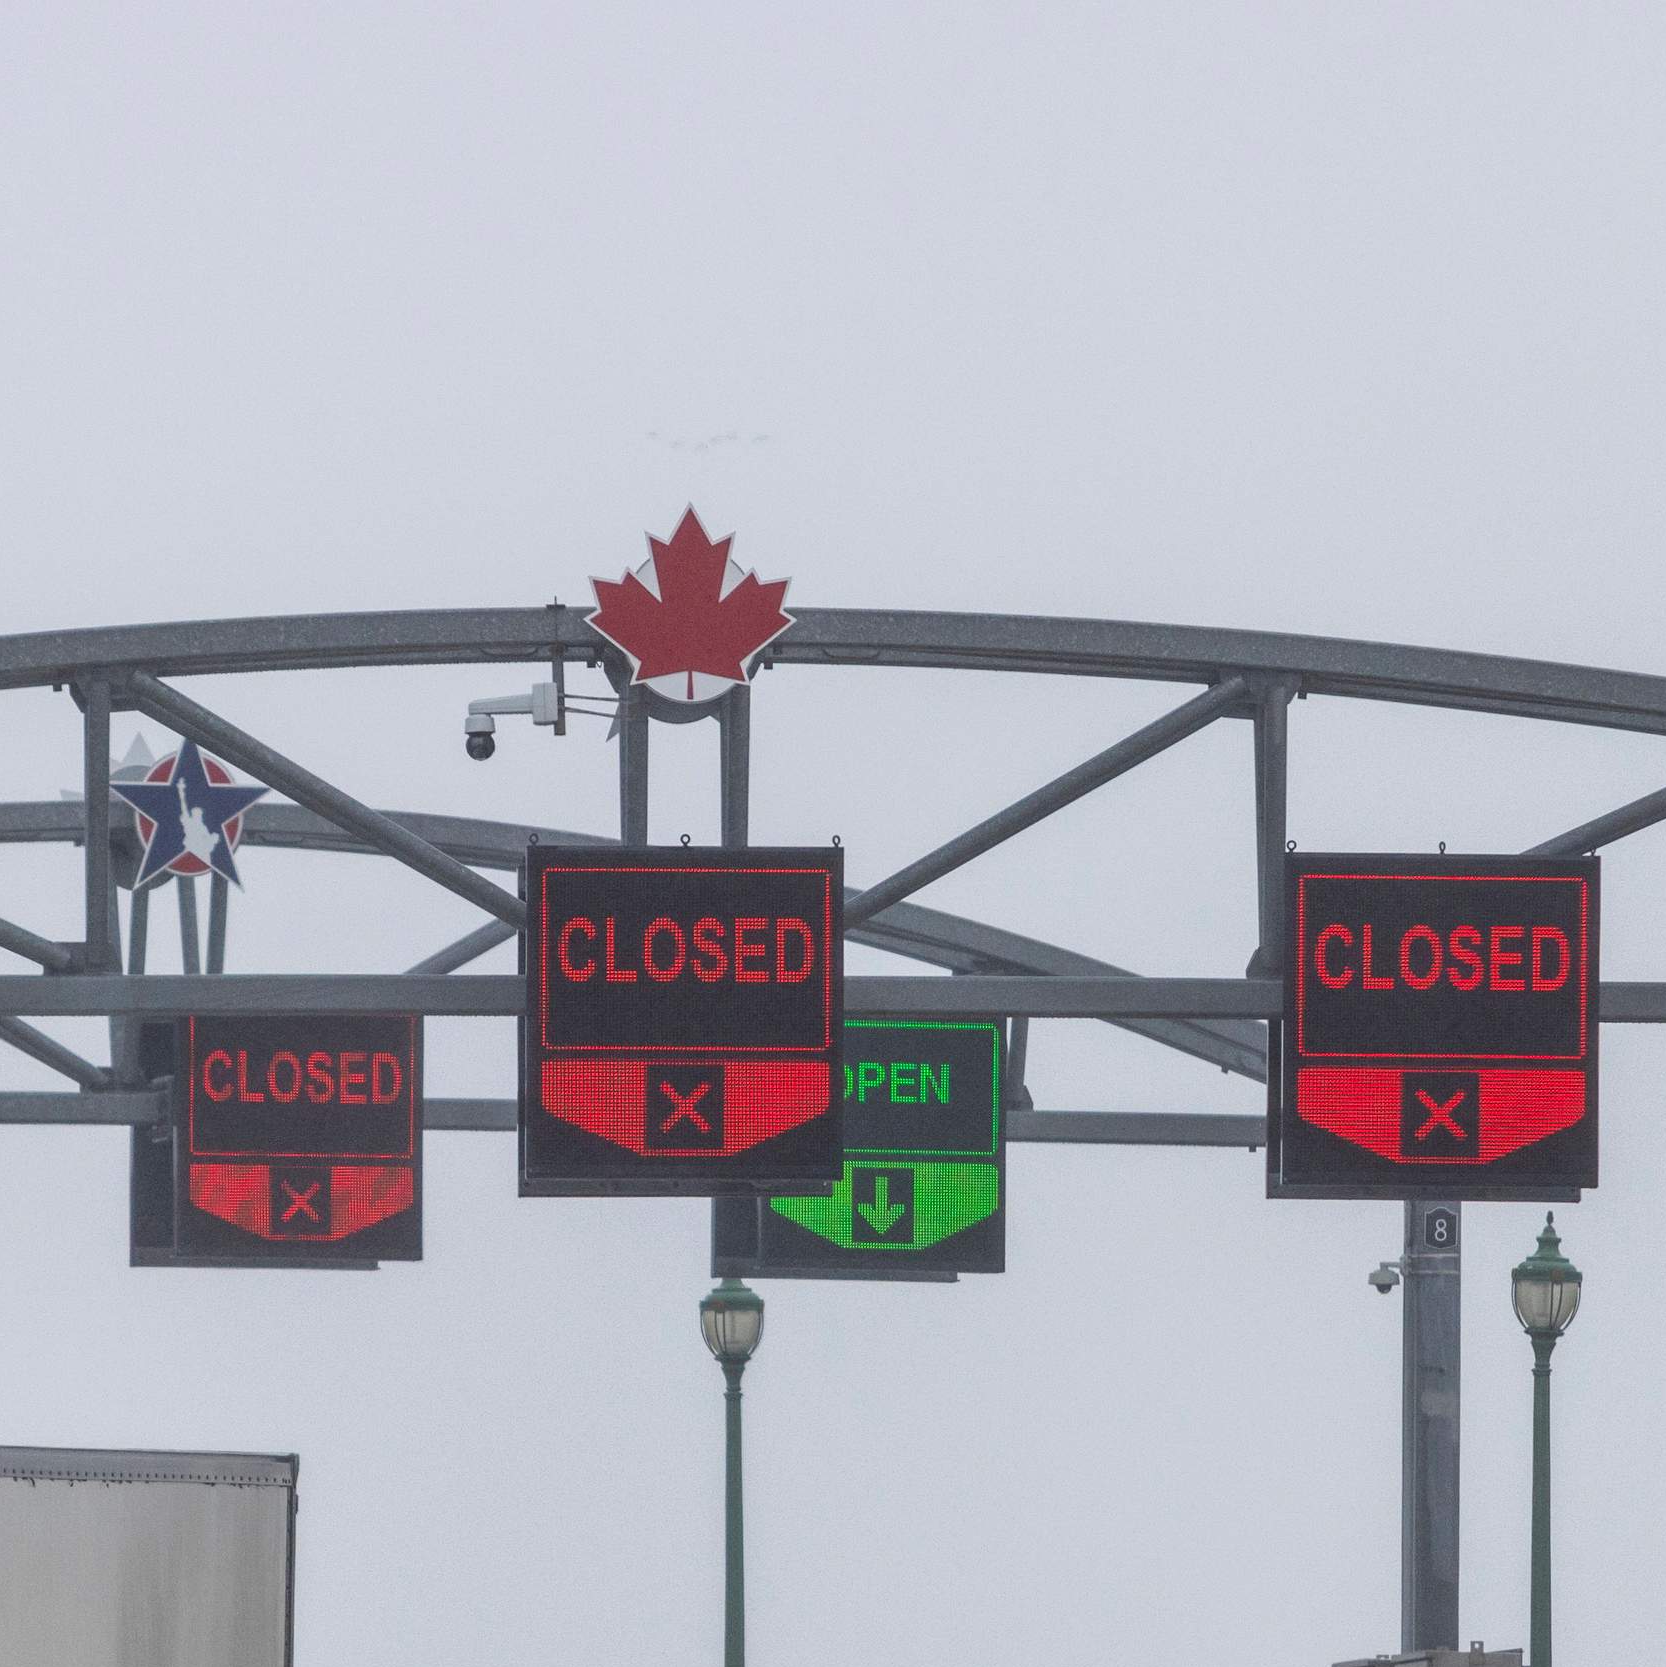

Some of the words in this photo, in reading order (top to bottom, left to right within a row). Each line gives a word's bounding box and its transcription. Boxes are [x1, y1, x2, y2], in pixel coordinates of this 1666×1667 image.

[558, 916, 815, 983] CLOSED
[1315, 923, 1571, 991] CLOSED
[203, 1049, 403, 1105] CLOSED
[1435, 1219, 1447, 1241] 8
